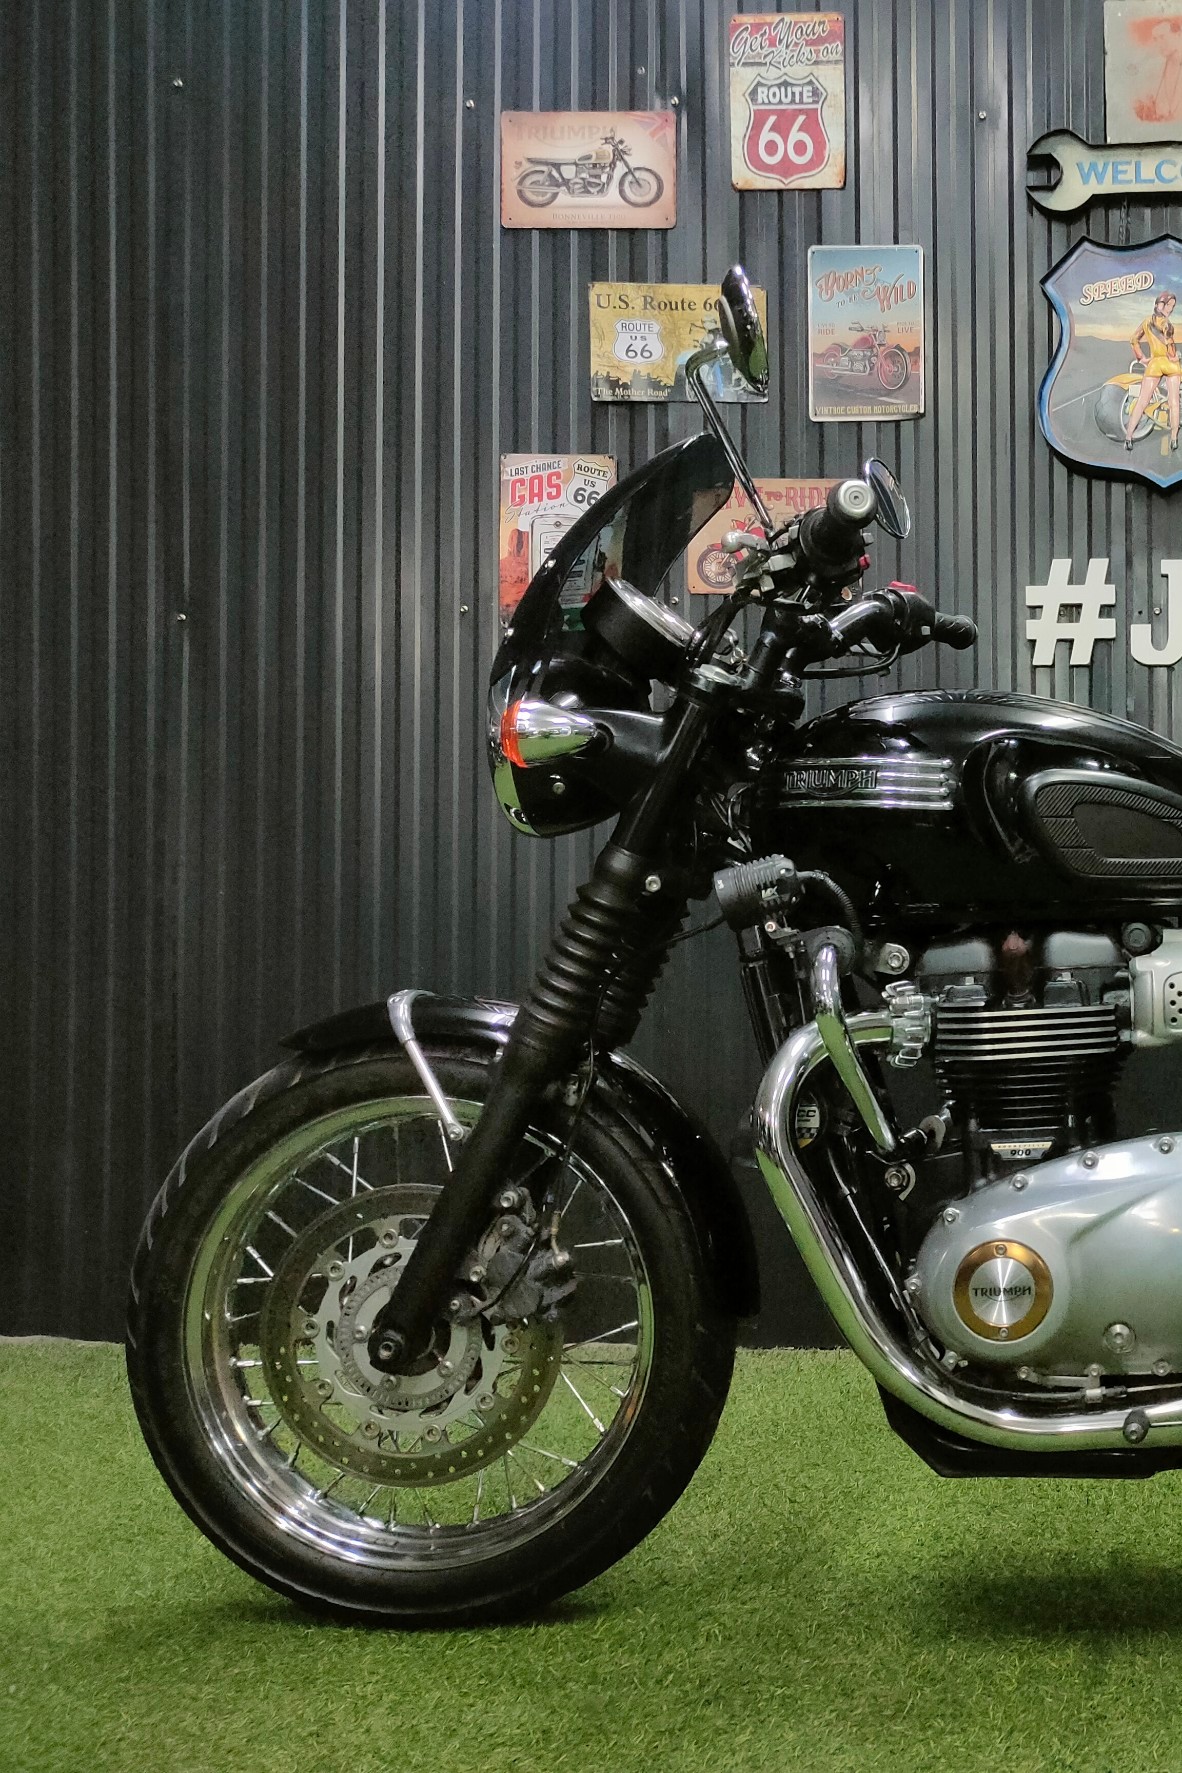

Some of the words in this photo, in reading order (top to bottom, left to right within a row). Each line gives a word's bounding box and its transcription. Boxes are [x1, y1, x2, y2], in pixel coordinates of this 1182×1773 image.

[732, 25, 768, 66] Get
[772, 17, 828, 48] Your
[762, 43, 815, 73] Kicks
[822, 43, 841, 56] on
[757, 86, 814, 104] ROUTE
[515, 125, 617, 141] TRIUMPH
[758, 115, 814, 165] 66
[815, 265, 882, 302] BORN
[861, 273, 917, 313] WILD
[1080, 271, 1155, 306] SPEED
[595, 293, 635, 310] U.S.
[642, 295, 697, 312] Route
[621, 322, 654, 333] ROUTE
[625, 343, 653, 359] 66
[615, 387, 644, 396] Mother
[510, 465, 528, 477] LAST
[531, 460, 562, 473] CHANCE
[576, 464, 608, 478] ROUTE
[510, 471, 562, 507] GAS
[583, 479, 596, 487] US
[573, 487, 601, 507] 66
[785, 487, 833, 513] RID
[505, 502, 568, 523] Station
[785, 769, 878, 792] TRIUMPH
[1010, 1148, 1031, 1156] 900
[972, 1286, 1031, 1298] TRIUMPH
